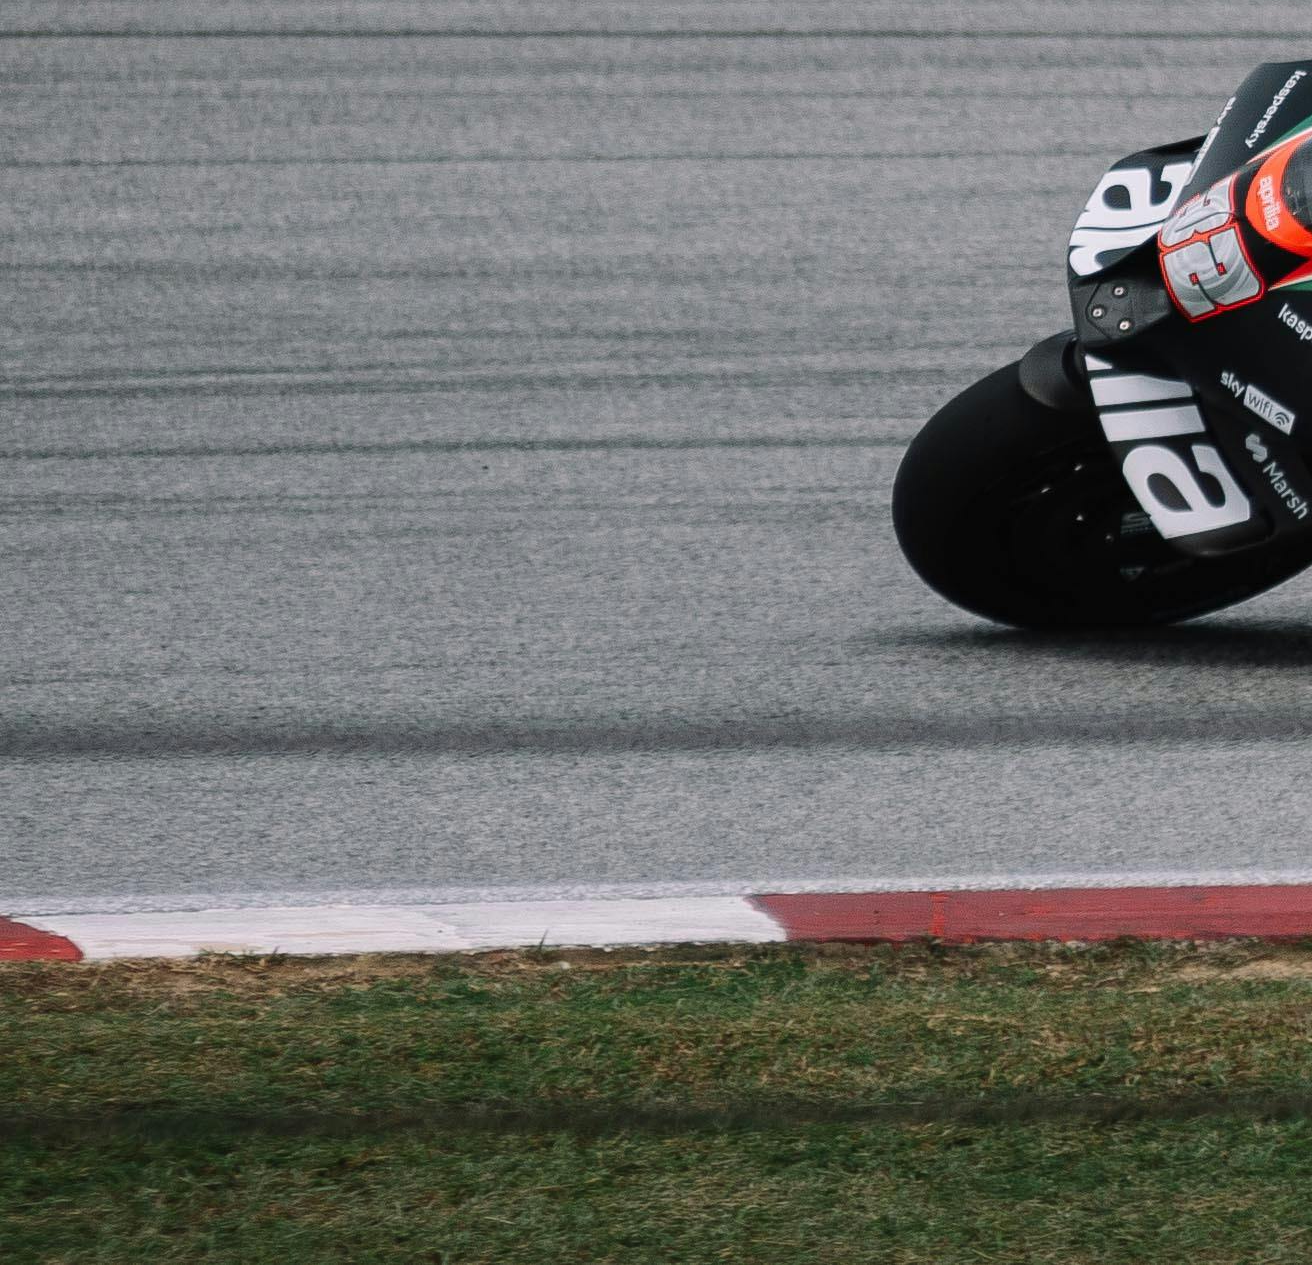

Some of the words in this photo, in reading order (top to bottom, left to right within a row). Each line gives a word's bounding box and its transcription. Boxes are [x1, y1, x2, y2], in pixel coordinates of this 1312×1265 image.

[1244, 70, 1307, 149] kaspersky
[1258, 175, 1280, 232] aprilia
[1220, 370, 1245, 398] sky
[1248, 388, 1274, 418] wifi
[1262, 462, 1308, 520] Marsh
